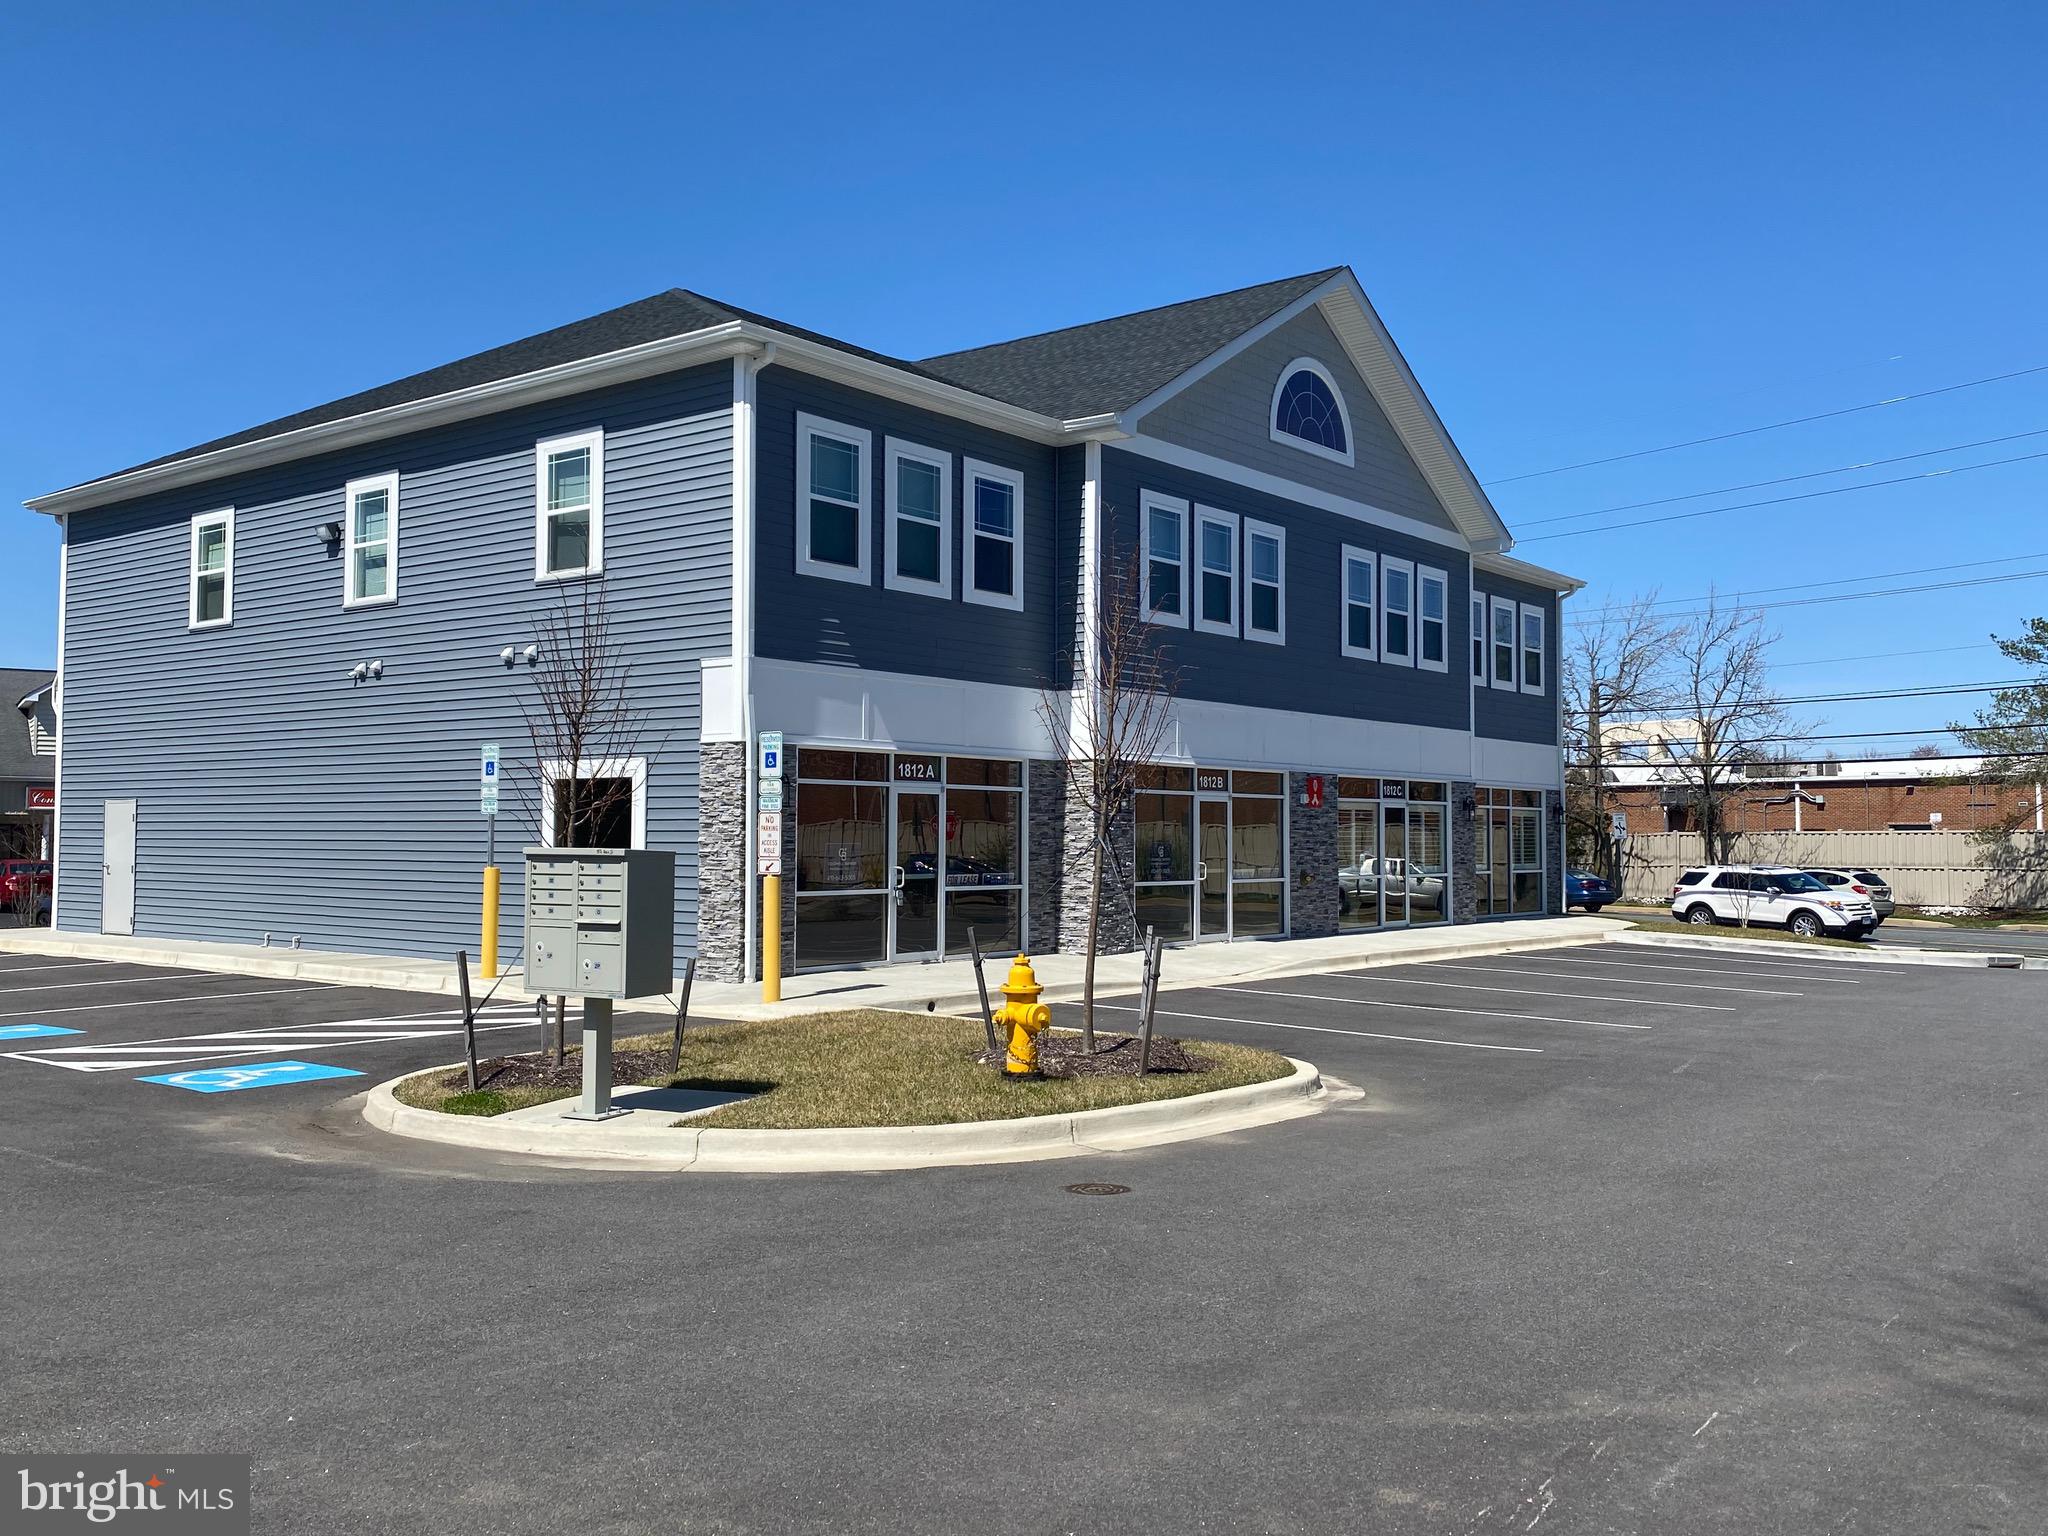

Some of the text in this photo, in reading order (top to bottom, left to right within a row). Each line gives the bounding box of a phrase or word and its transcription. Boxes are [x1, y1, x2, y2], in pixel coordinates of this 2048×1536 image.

[898, 763, 924, 778] 1812
[765, 816, 774, 824] NO
[960, 875, 977, 884] LEASE
